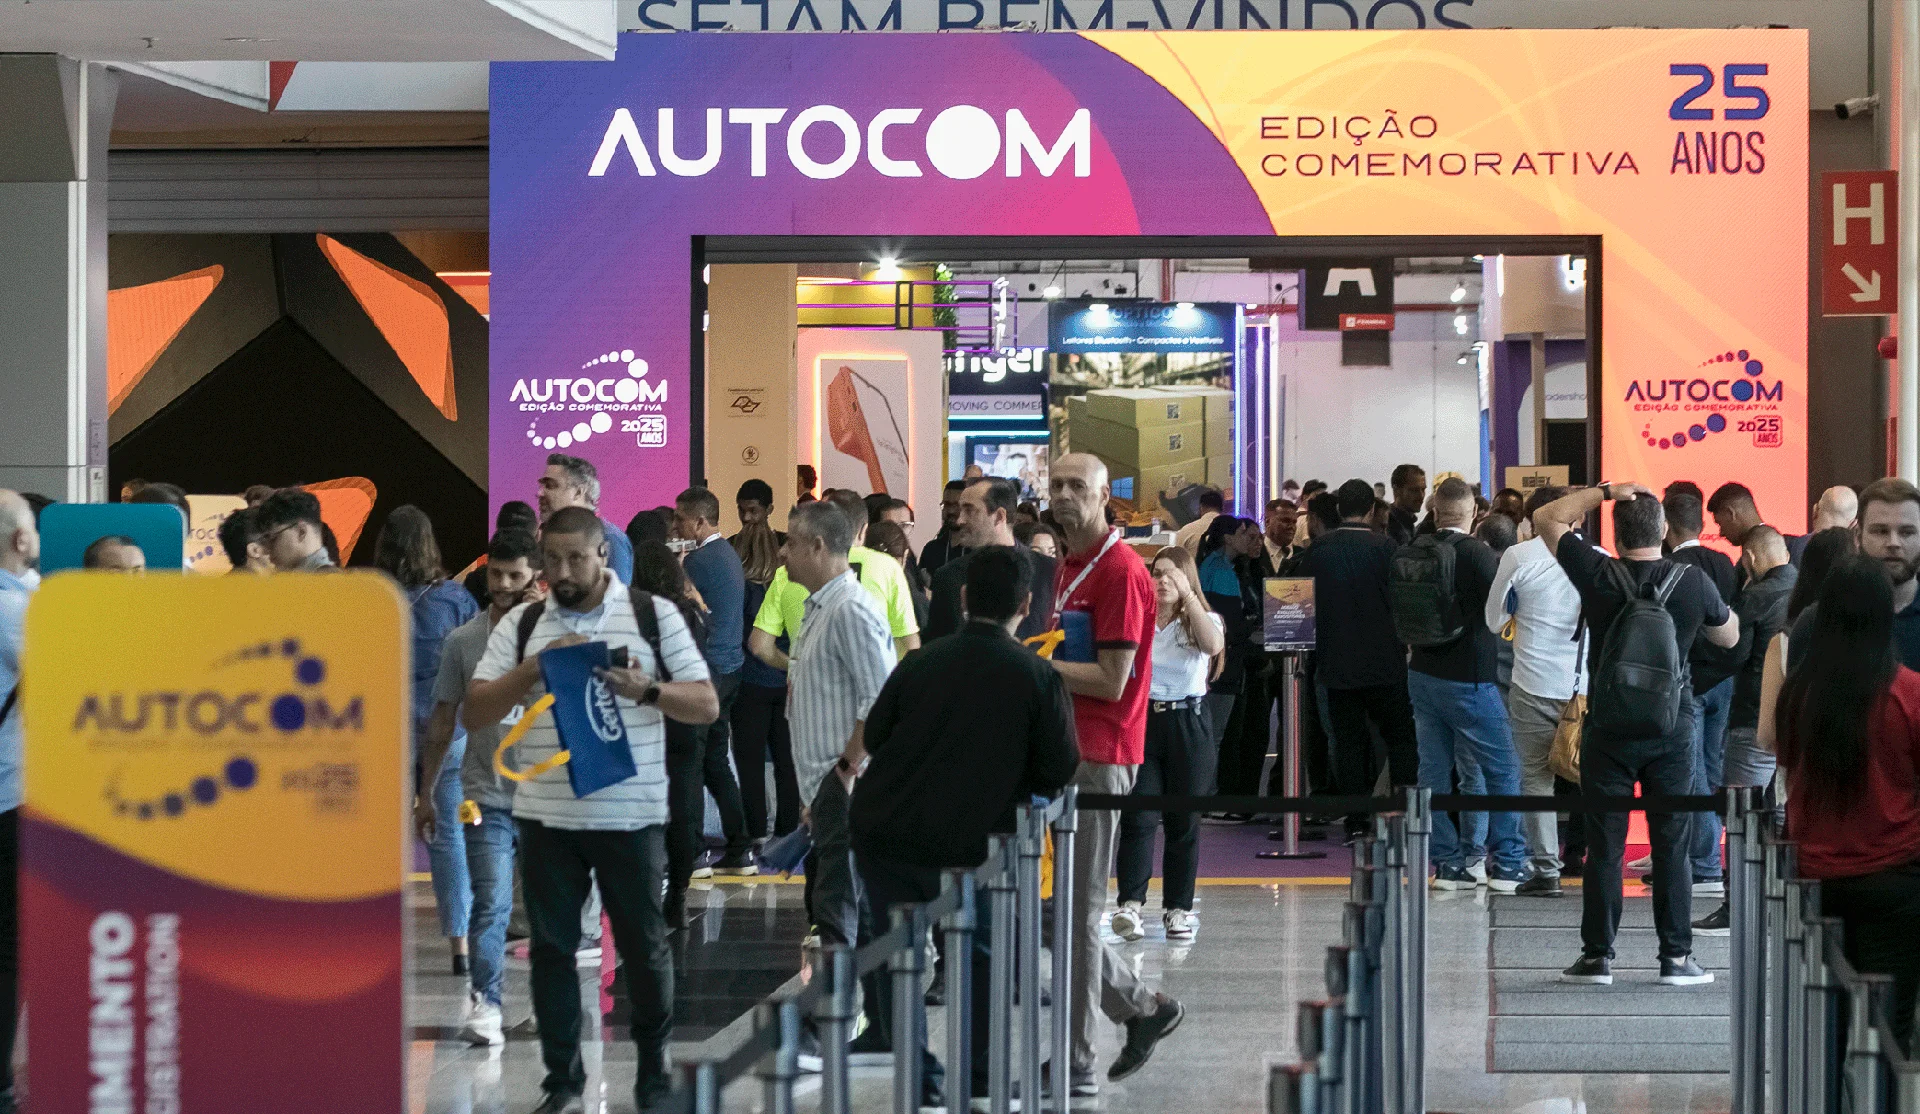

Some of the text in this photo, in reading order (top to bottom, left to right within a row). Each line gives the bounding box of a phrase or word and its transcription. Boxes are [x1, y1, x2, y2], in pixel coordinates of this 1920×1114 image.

[1669, 64, 1772, 120] 25
[1260, 109, 1438, 145] EDIÇÃO
[587, 104, 1091, 180] AUTOCOM
[1671, 131, 1766, 174] ANOS
[1261, 152, 1640, 176] COMEMORATIVA
[1833, 183, 1885, 245] H
[509, 378, 668, 403] AUTOCOM
[1624, 379, 1783, 402] AUTOCOM
[519, 402, 663, 414] EDIÇÃO COMEMORATIVA
[1633, 402, 1779, 413] EDIÇÃO COMEMORATIVA
[620, 418, 664, 432] 2025
[1737, 418, 1780, 432] 2025
[73, 690, 364, 735] AUTOCOM
